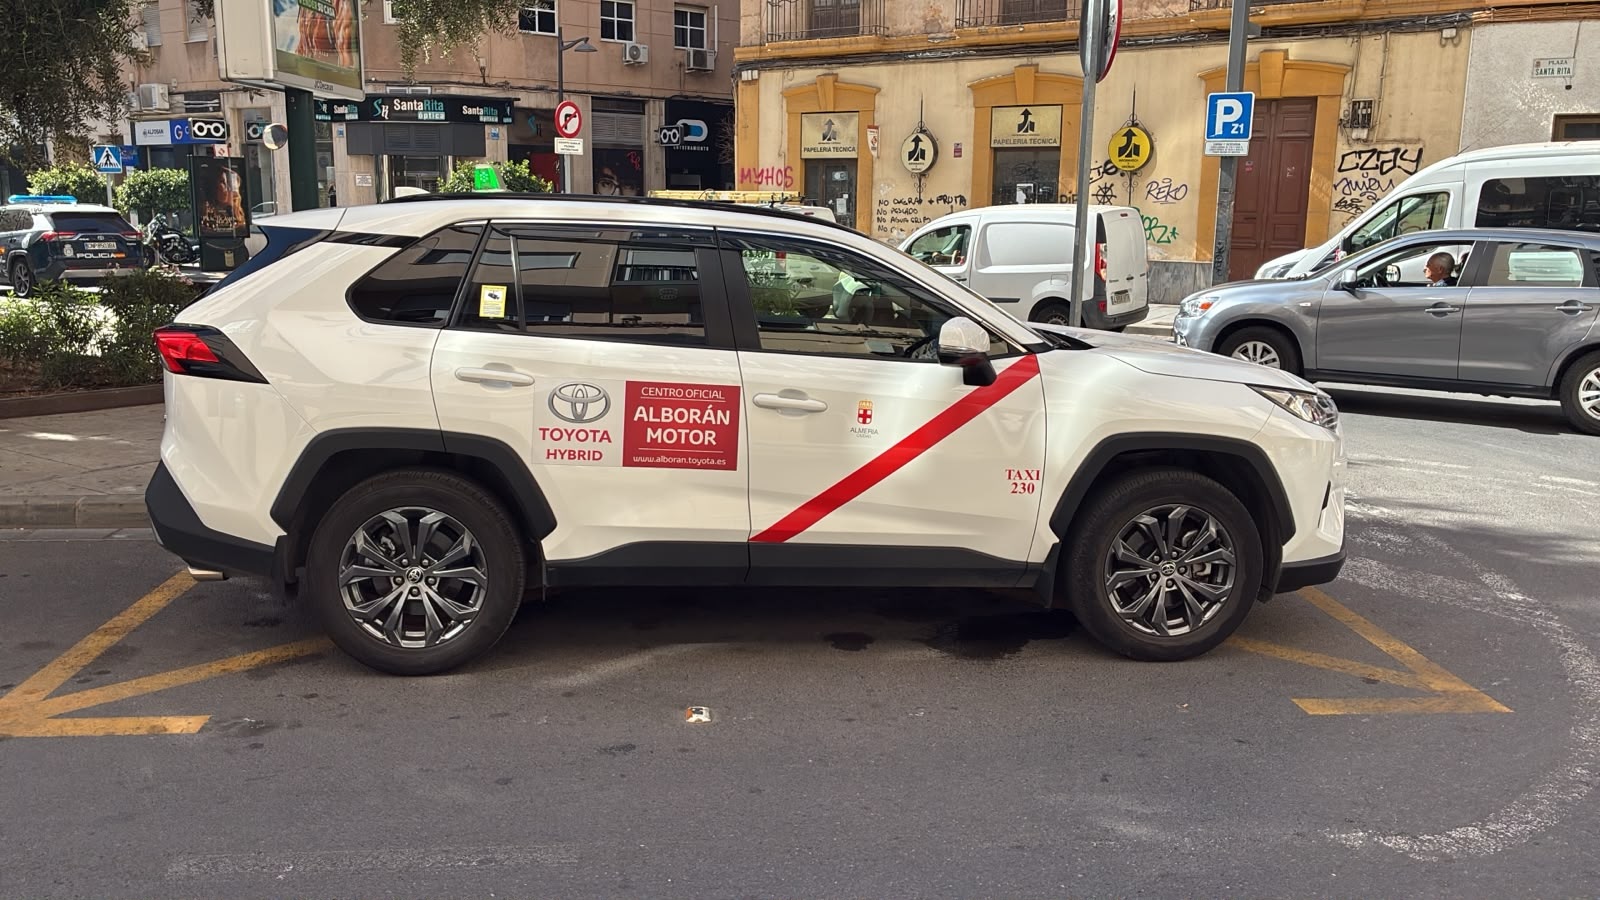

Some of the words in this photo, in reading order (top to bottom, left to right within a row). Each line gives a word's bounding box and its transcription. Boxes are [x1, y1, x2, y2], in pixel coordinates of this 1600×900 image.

[1557, 67, 1571, 75] RITA
[393, 98, 444, 111] SantaRita
[462, 105, 498, 115] SantaRita
[1215, 98, 1243, 135] P
[1231, 123, 1244, 134] Z1
[879, 199, 889, 207] NO
[877, 208, 887, 216] NO
[641, 386, 684, 398] CENTRO
[687, 388, 725, 399] OFICIAL
[633, 404, 731, 425] ALBORÁN
[539, 427, 612, 444] TOYOTA
[646, 427, 717, 446] MOTOR
[546, 448, 603, 461] HYBRID
[633, 455, 727, 466] www.alboran.toyota.es
[1005, 469, 1040, 481] TAXI
[1010, 482, 1035, 494] 230
